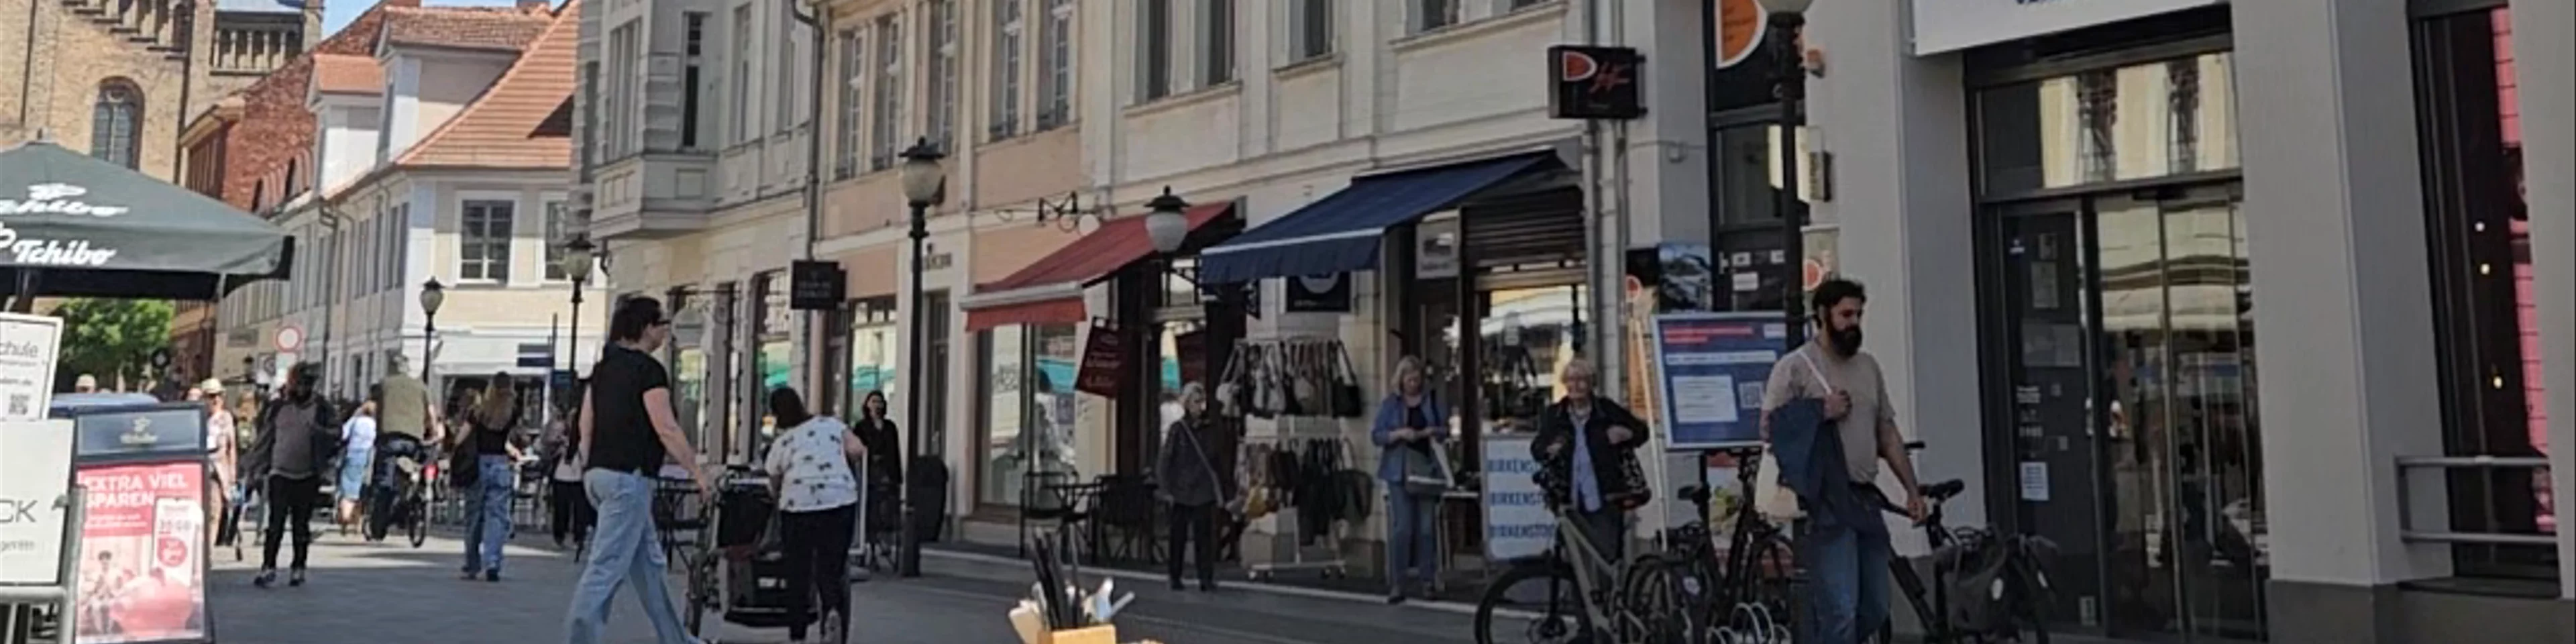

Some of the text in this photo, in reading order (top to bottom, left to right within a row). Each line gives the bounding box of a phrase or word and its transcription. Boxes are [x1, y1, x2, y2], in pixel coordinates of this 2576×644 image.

[0, 199, 129, 217] chibo
[11, 239, 117, 266] Tchibo
[85, 473, 187, 492] EXTRA VIEL
[87, 491, 155, 508] SPAREN
